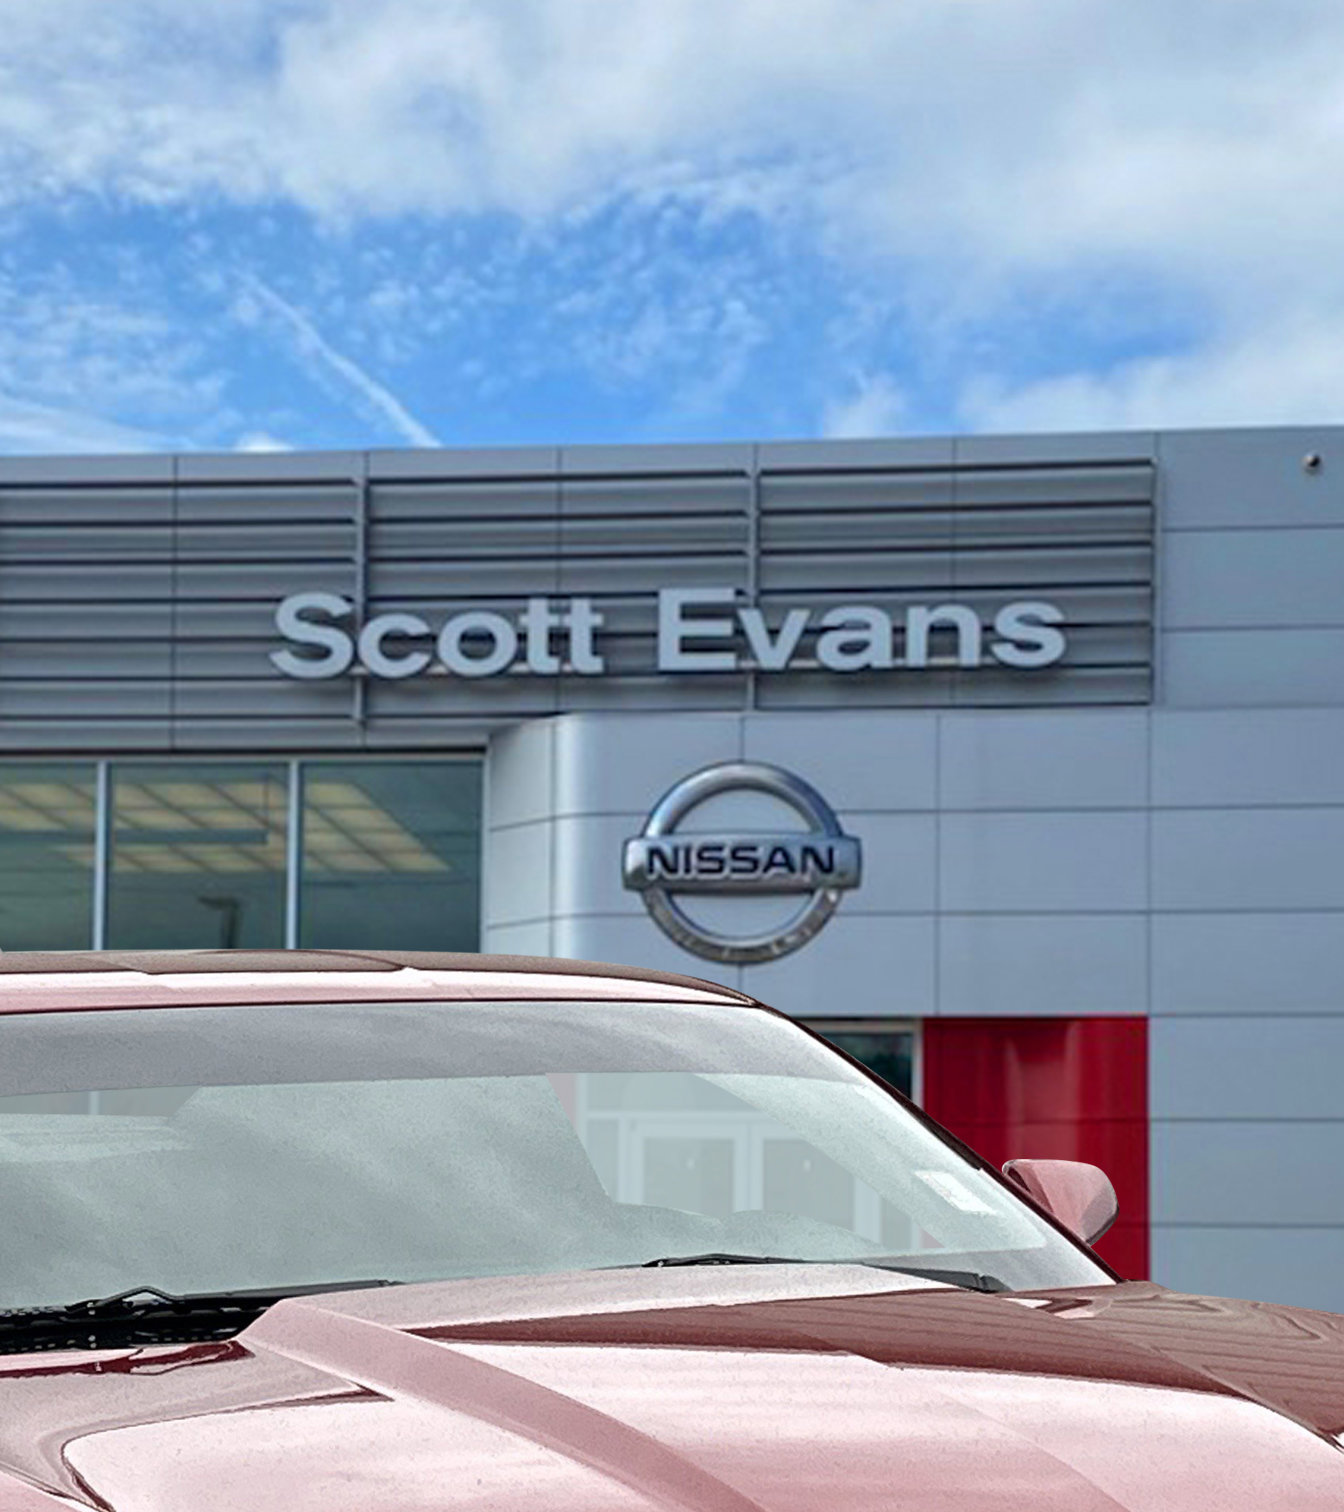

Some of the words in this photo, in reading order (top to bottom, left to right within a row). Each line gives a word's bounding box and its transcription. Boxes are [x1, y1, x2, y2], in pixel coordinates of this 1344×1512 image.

[269, 592, 605, 678] Scott
[657, 586, 1068, 673] Evans
[646, 844, 835, 877] NISSAN
